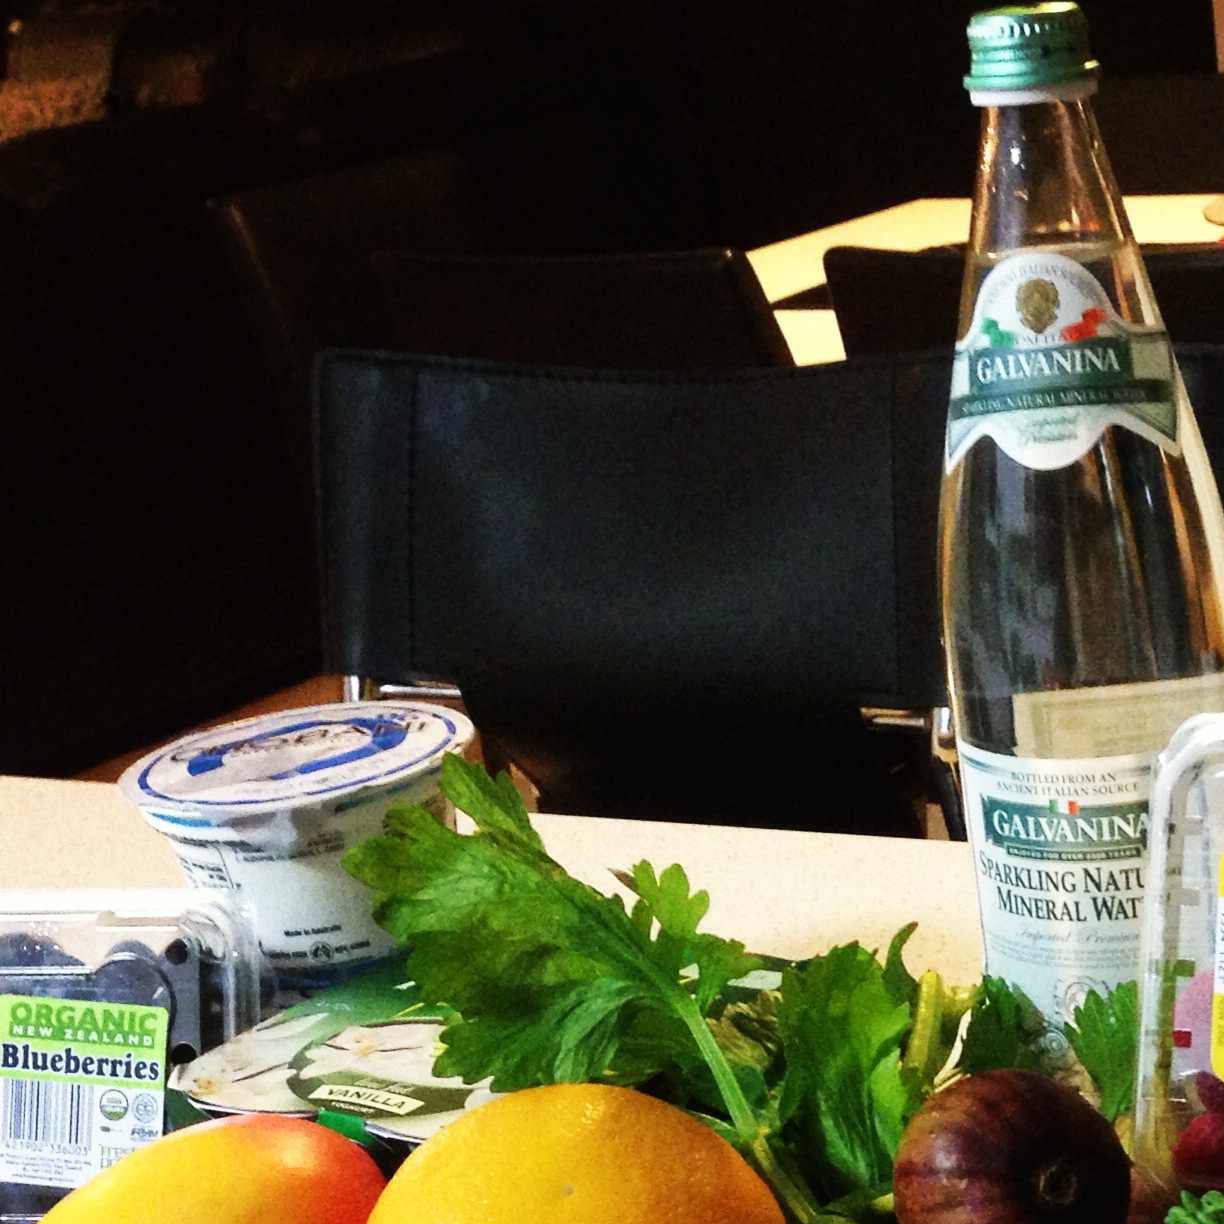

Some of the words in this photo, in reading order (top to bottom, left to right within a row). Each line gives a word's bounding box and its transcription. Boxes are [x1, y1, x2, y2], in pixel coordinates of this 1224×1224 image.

[977, 347, 1121, 385] GALVANINA
[1011, 771, 1059, 784] BOTTLED
[1062, 773, 1096, 784] FROM
[1099, 771, 1117, 782] AN
[1093, 782, 1139, 796] SOURCE
[993, 809, 1150, 842] GALVANINA
[979, 850, 1076, 894] SPARKLING
[997, 885, 1087, 922] MINERAL
[10, 1001, 159, 1033] ORGANIC
[12, 1024, 53, 1038] NEW
[64, 1028, 155, 1046] ZEALAND
[0, 1043, 160, 1081] Blueberries
[328, 1088, 408, 1110] VANILLA
